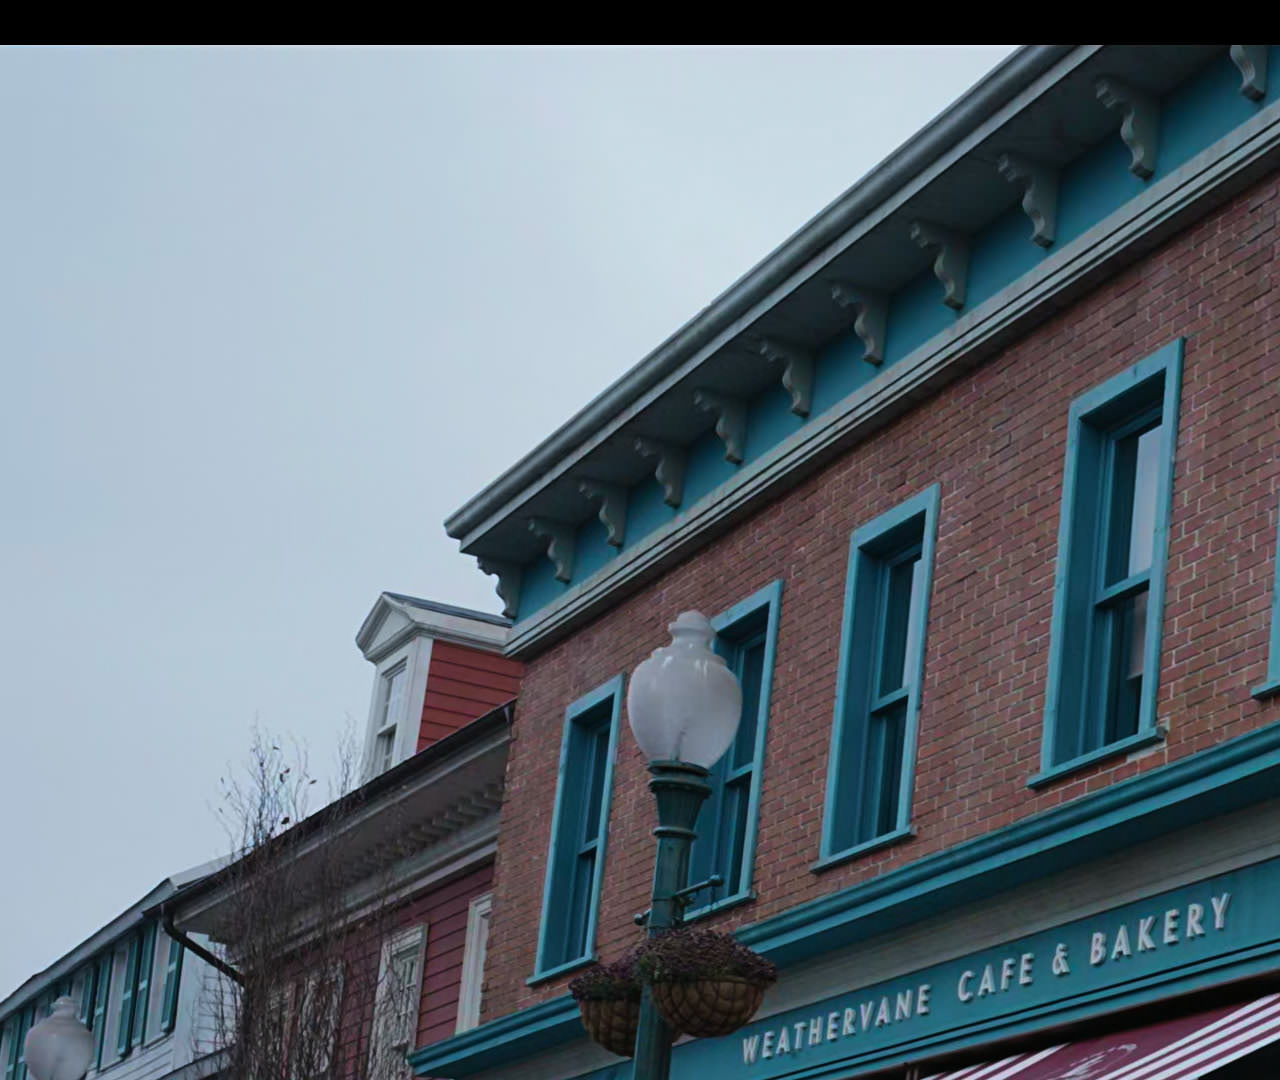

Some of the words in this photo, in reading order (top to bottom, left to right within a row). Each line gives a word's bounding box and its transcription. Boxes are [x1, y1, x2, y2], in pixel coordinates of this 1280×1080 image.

[743, 983, 931, 1064] WEATHERVANE
[957, 952, 1034, 1003] CAFE
[1052, 942, 1071, 976] &
[1090, 892, 1231, 965] BAKERY
